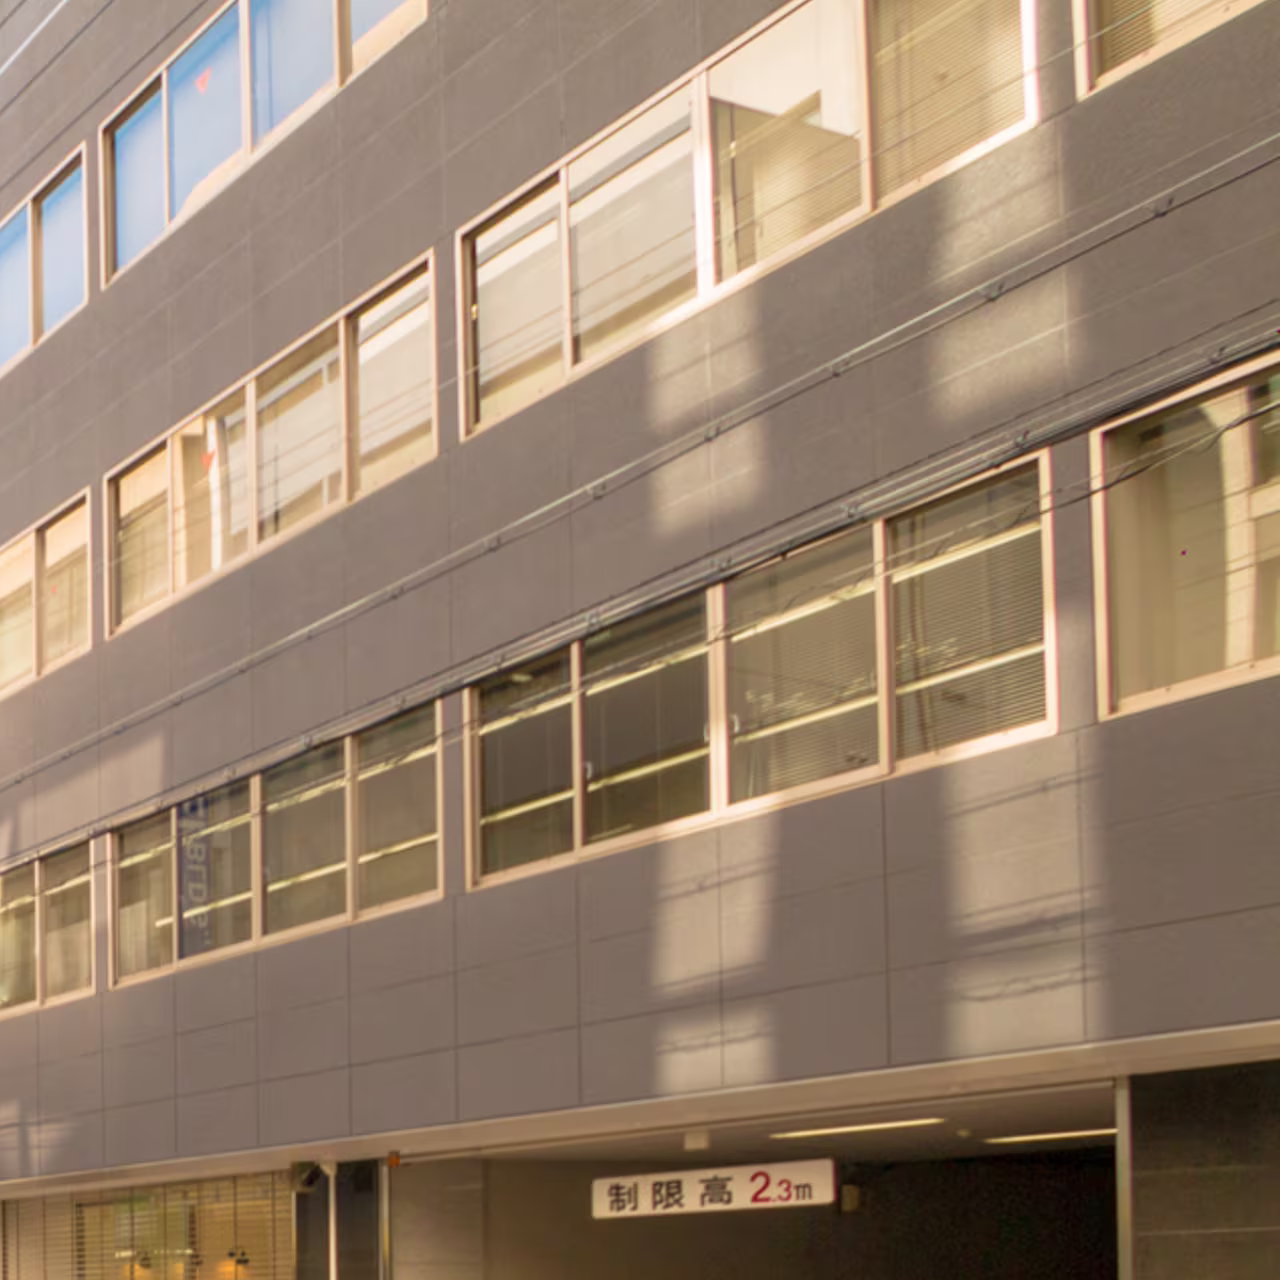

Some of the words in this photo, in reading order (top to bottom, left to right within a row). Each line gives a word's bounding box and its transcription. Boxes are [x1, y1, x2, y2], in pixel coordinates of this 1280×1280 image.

[607, 1175, 733, 1212] 制限高
[749, 1170, 813, 1204] 2.3m
